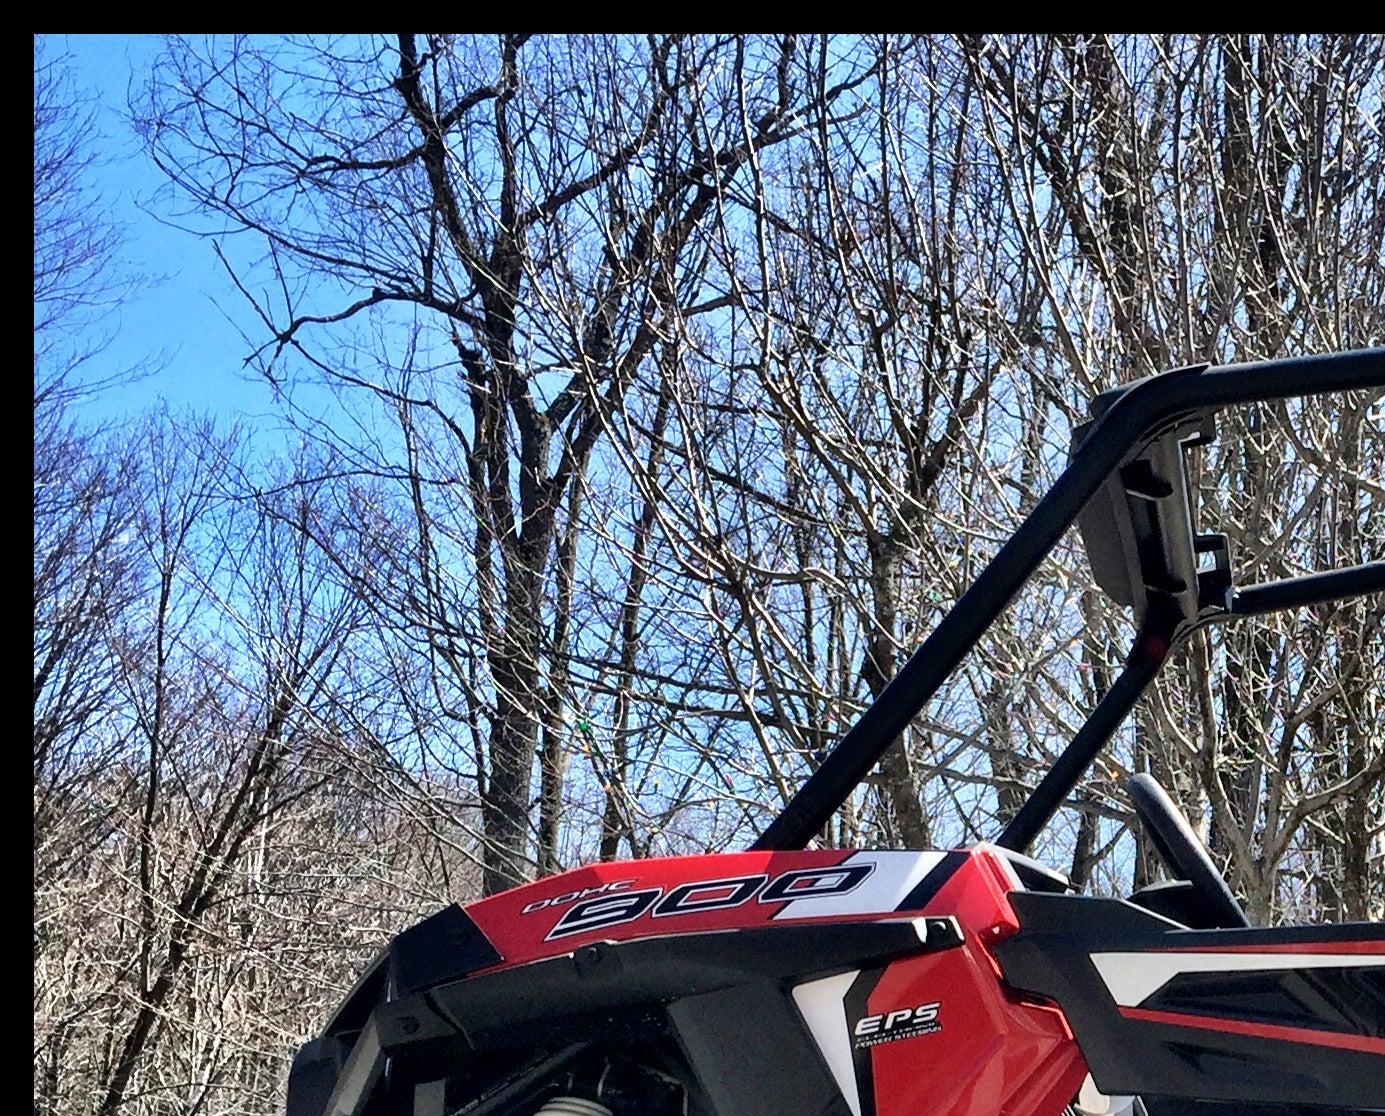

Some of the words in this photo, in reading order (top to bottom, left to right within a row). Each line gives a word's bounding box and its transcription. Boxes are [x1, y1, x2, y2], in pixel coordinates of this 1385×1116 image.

[521, 880, 638, 914] DOHC
[544, 861, 876, 941] 900
[855, 1002, 941, 1035] EPS
